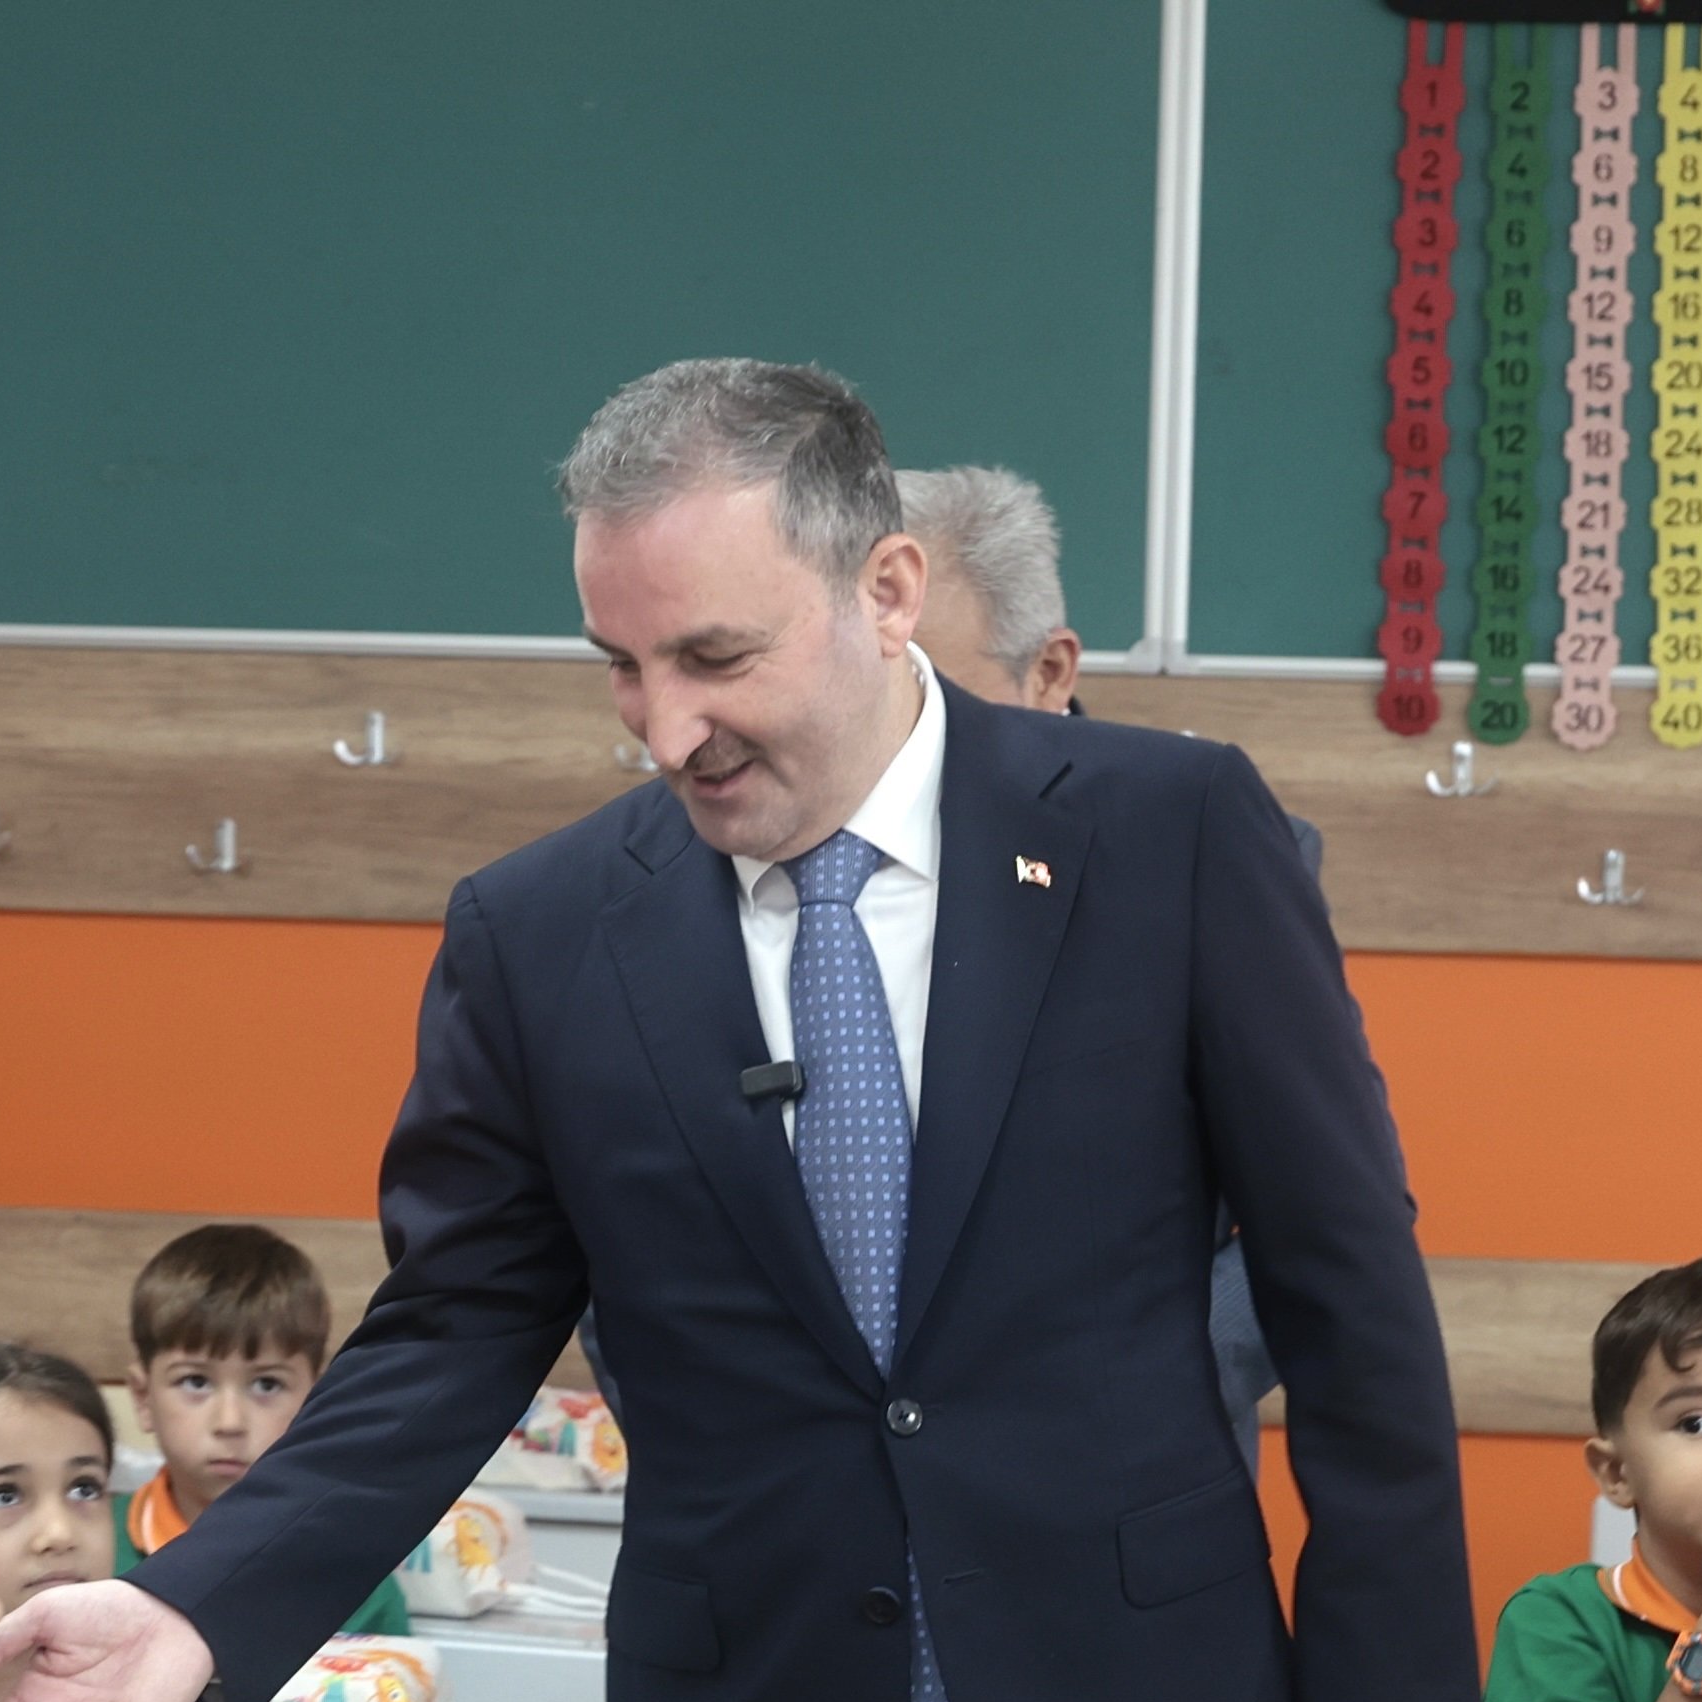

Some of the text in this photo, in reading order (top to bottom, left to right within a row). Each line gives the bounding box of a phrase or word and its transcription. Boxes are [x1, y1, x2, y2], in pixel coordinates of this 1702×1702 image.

[1426, 80, 1438, 107] 1
[1510, 81, 1530, 112] 2
[1598, 81, 1617, 111] 3
[1680, 85, 1700, 111] 4
[1420, 149, 1440, 181] 2
[1507, 153, 1528, 178] 4
[1593, 154, 1613, 182] 6
[1679, 155, 1698, 183] 8
[1418, 218, 1438, 248] 3
[1505, 220, 1526, 248] 6
[1594, 225, 1614, 253] 9
[1670, 224, 1702, 253] 12
[1413, 292, 1434, 317] 4
[1503, 289, 1524, 316] 8
[1583, 291, 1616, 322] 12
[1669, 292, 1701, 320] 16
[1412, 356, 1432, 385] 5
[1495, 359, 1529, 387] 10
[1582, 363, 1614, 392] 15
[1407, 423, 1428, 453] 6
[1493, 424, 1527, 455] 12
[1582, 430, 1613, 458] 18
[1409, 491, 1427, 519] 7
[1491, 496, 1523, 522] 14
[1577, 500, 1610, 530] 21
[1402, 561, 1424, 589] 8
[1488, 564, 1520, 592] 16
[1572, 566, 1611, 596] 24
[1664, 566, 1702, 596] 32
[1402, 626, 1424, 654] 9
[1486, 631, 1518, 659] 18
[1569, 634, 1607, 663] 27
[1664, 635, 1702, 664] 36
[1393, 695, 1425, 723] 10
[1481, 700, 1518, 730] 20
[1566, 703, 1604, 732] 30
[1661, 705, 1702, 731] 40
